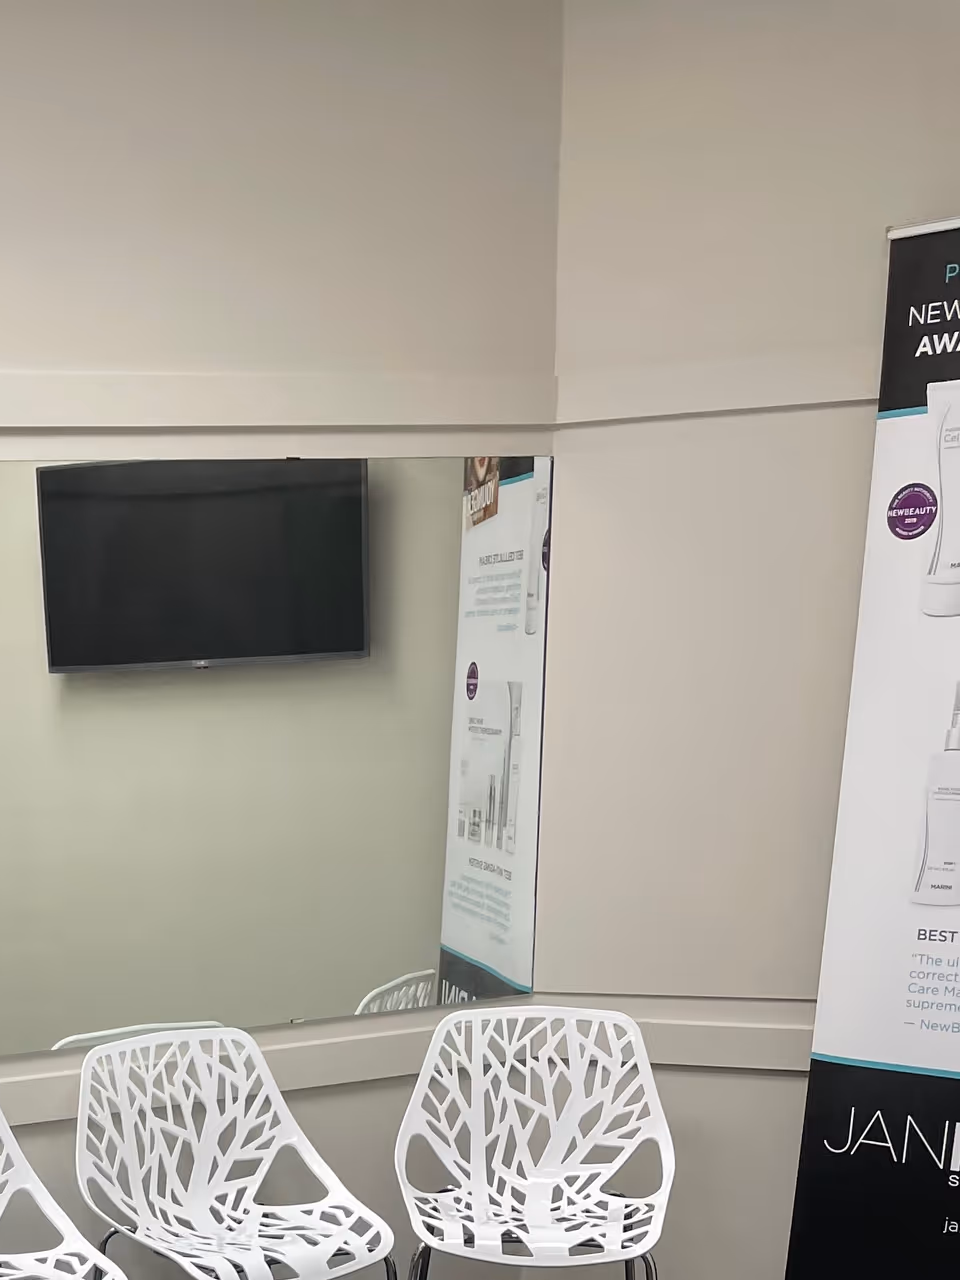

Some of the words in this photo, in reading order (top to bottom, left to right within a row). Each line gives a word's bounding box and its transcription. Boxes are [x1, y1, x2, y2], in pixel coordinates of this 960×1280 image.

[907, 299, 960, 327] NEW
[914, 331, 960, 357] AW
[887, 506, 937, 518] NEWBEAUTY
[917, 928, 959, 943] BEST
[909, 970, 960, 983] correct
[908, 982, 940, 996] Care
[920, 1018, 960, 1034] NewB
[823, 1106, 960, 1171] JAN
[942, 1216, 960, 1234] ja
